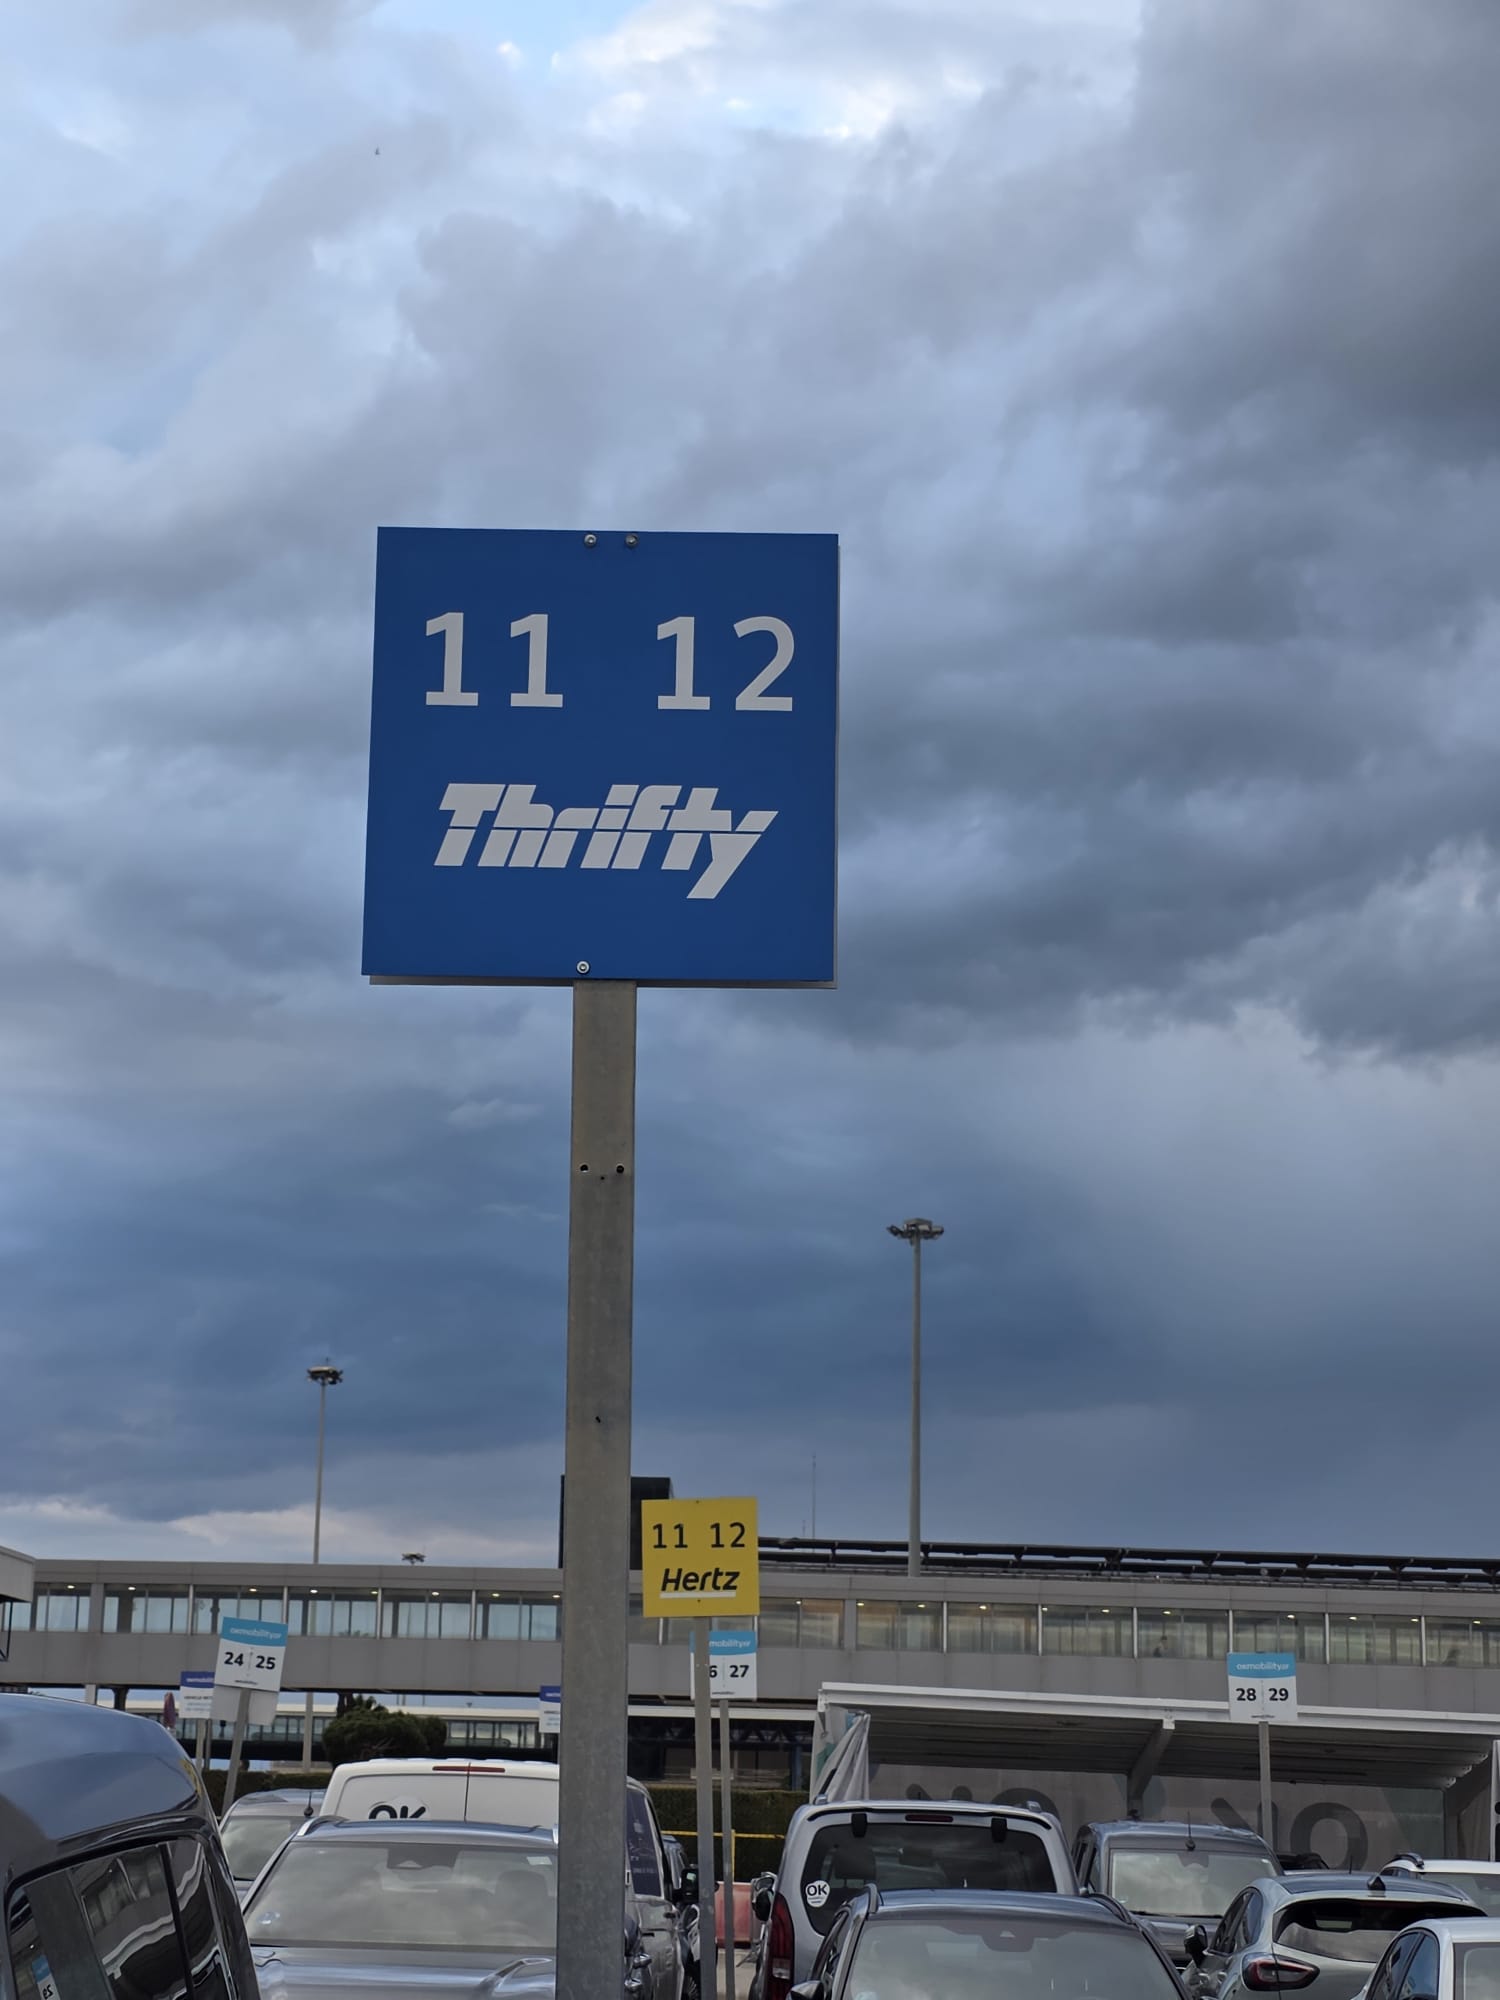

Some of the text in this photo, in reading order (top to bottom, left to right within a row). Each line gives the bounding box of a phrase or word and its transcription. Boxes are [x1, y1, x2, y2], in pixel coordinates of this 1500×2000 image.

[426, 612, 795, 712] 11 12
[433, 783, 779, 899] Thrifty
[652, 1522, 746, 1549] 11 12
[661, 1567, 740, 1592] Hertz
[224, 1651, 276, 1670] 24 25
[709, 1664, 750, 1678] 6 27
[1235, 1687, 1289, 1701] 28 29
[807, 1884, 828, 1897] OK
